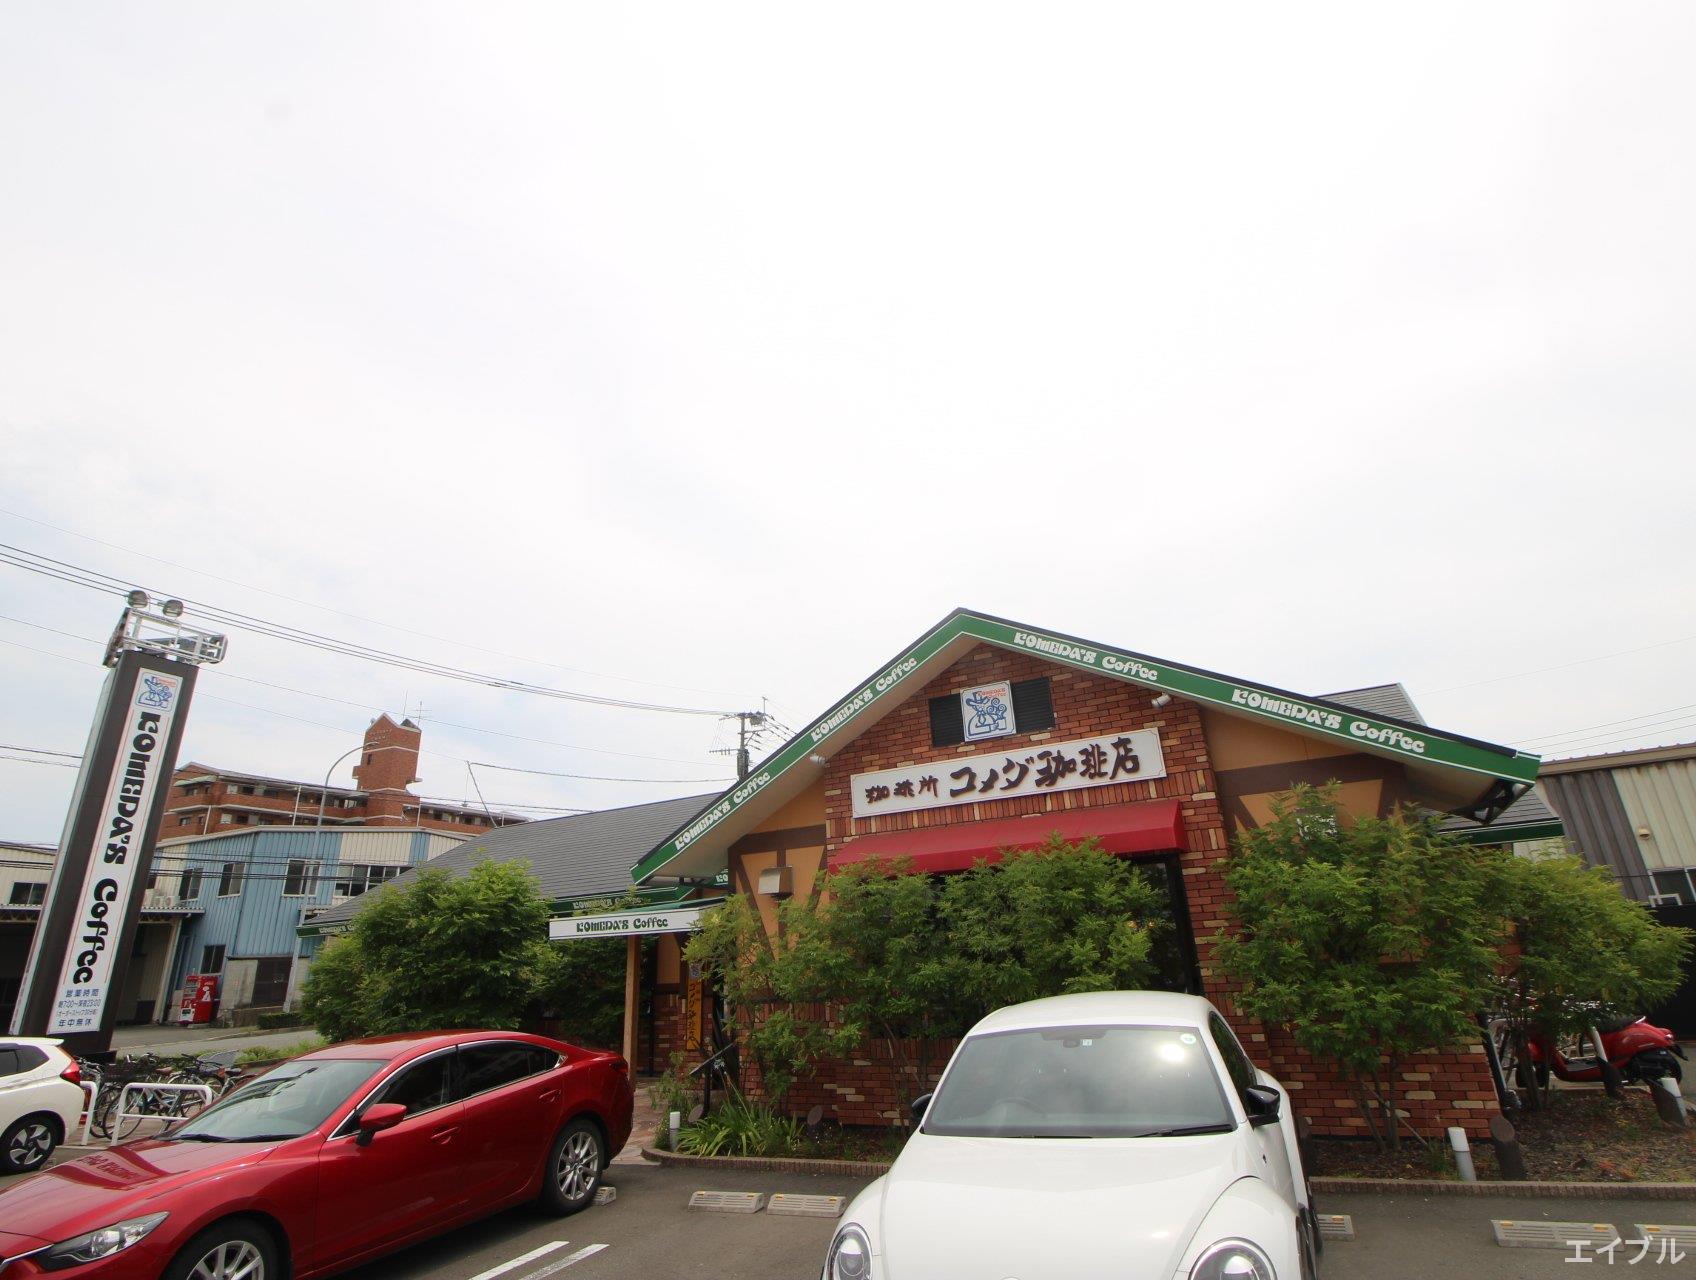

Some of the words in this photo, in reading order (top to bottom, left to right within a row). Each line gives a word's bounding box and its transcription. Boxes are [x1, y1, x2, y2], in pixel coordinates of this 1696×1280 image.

[1013, 631, 1098, 664] KOMEDA'S
[1102, 655, 1158, 681] Coffee
[811, 688, 873, 742] KOMEDA'S
[875, 658, 917, 691] Coffee
[1231, 689, 1342, 730] KOMEDA'S
[1349, 720, 1425, 753] Coffee
[103, 711, 161, 865] KOMEDA'S
[950, 736, 1140, 797] コメダ珈琲店
[674, 801, 731, 851] KOMEDA'S
[733, 772, 770, 804] Coffee
[73, 878, 118, 984] Coffee
[576, 919, 629, 932] KOMEDA'S
[633, 917, 668, 929] Coffee
[58, 1018, 93, 1027] 年中無休
